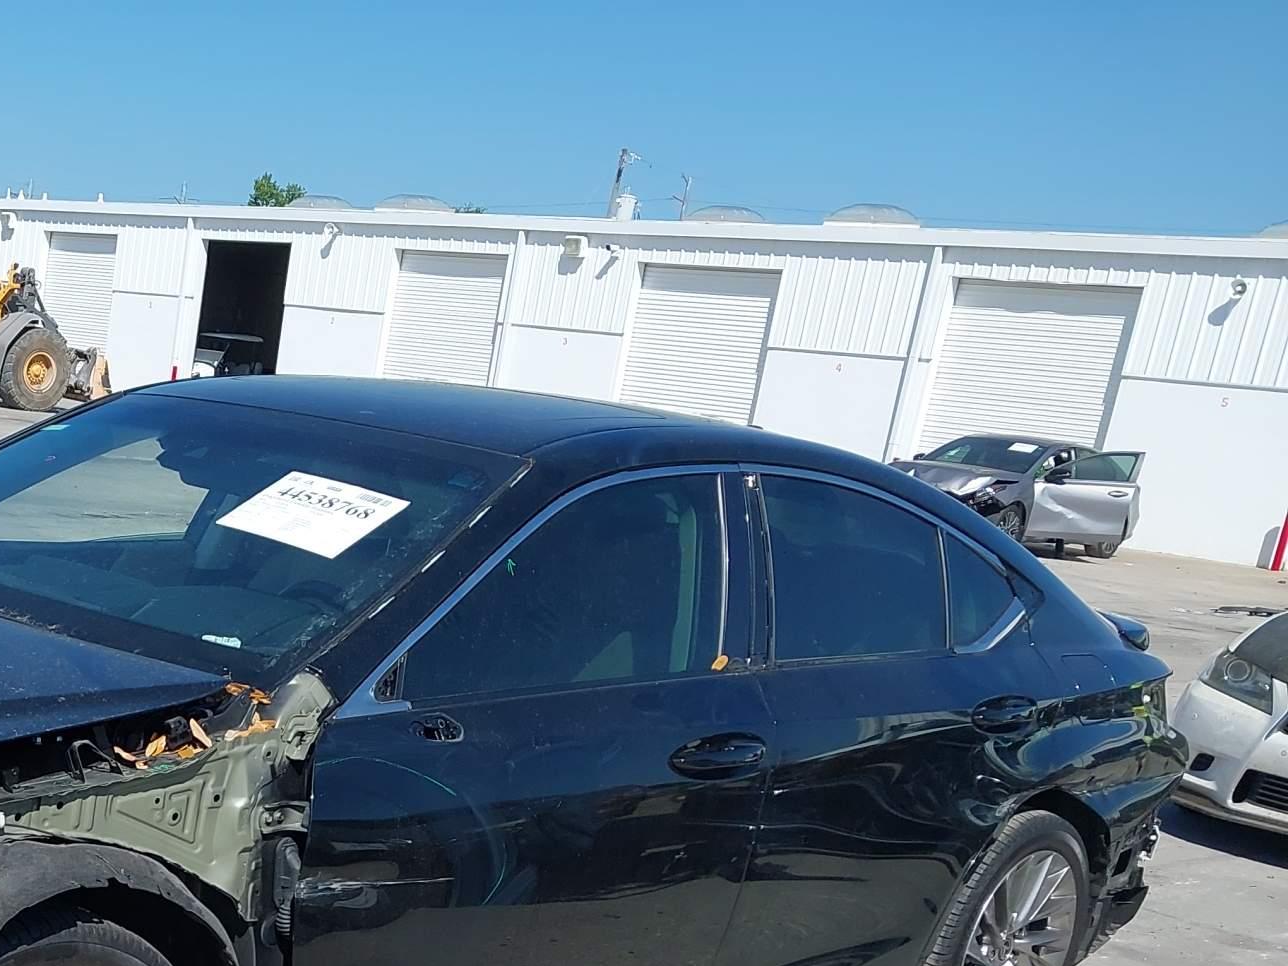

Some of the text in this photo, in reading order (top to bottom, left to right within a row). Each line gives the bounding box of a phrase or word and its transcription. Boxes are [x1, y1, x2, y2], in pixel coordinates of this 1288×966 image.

[835, 362, 842, 373] 4
[1220, 397, 1229, 408] 5
[277, 486, 376, 520] 44538768
